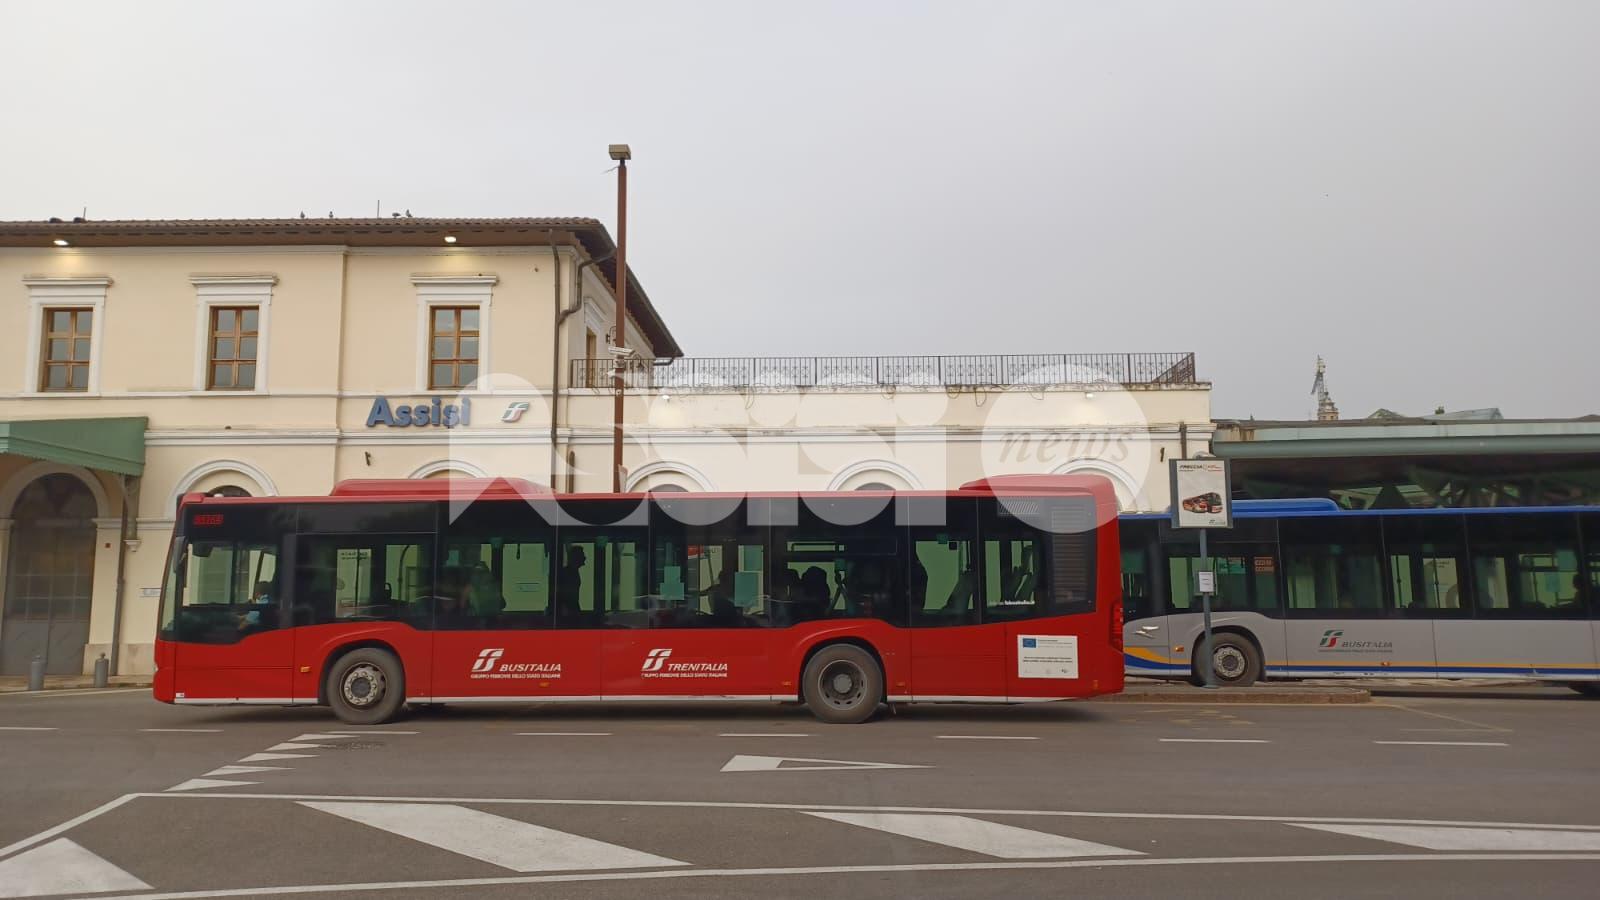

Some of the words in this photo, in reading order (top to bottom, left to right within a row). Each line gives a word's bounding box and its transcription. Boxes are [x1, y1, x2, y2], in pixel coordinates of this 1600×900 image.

[365, 395, 472, 428] Assisi
[499, 663, 562, 672] BUSITALIA
[667, 663, 728, 671] TRENITALIA
